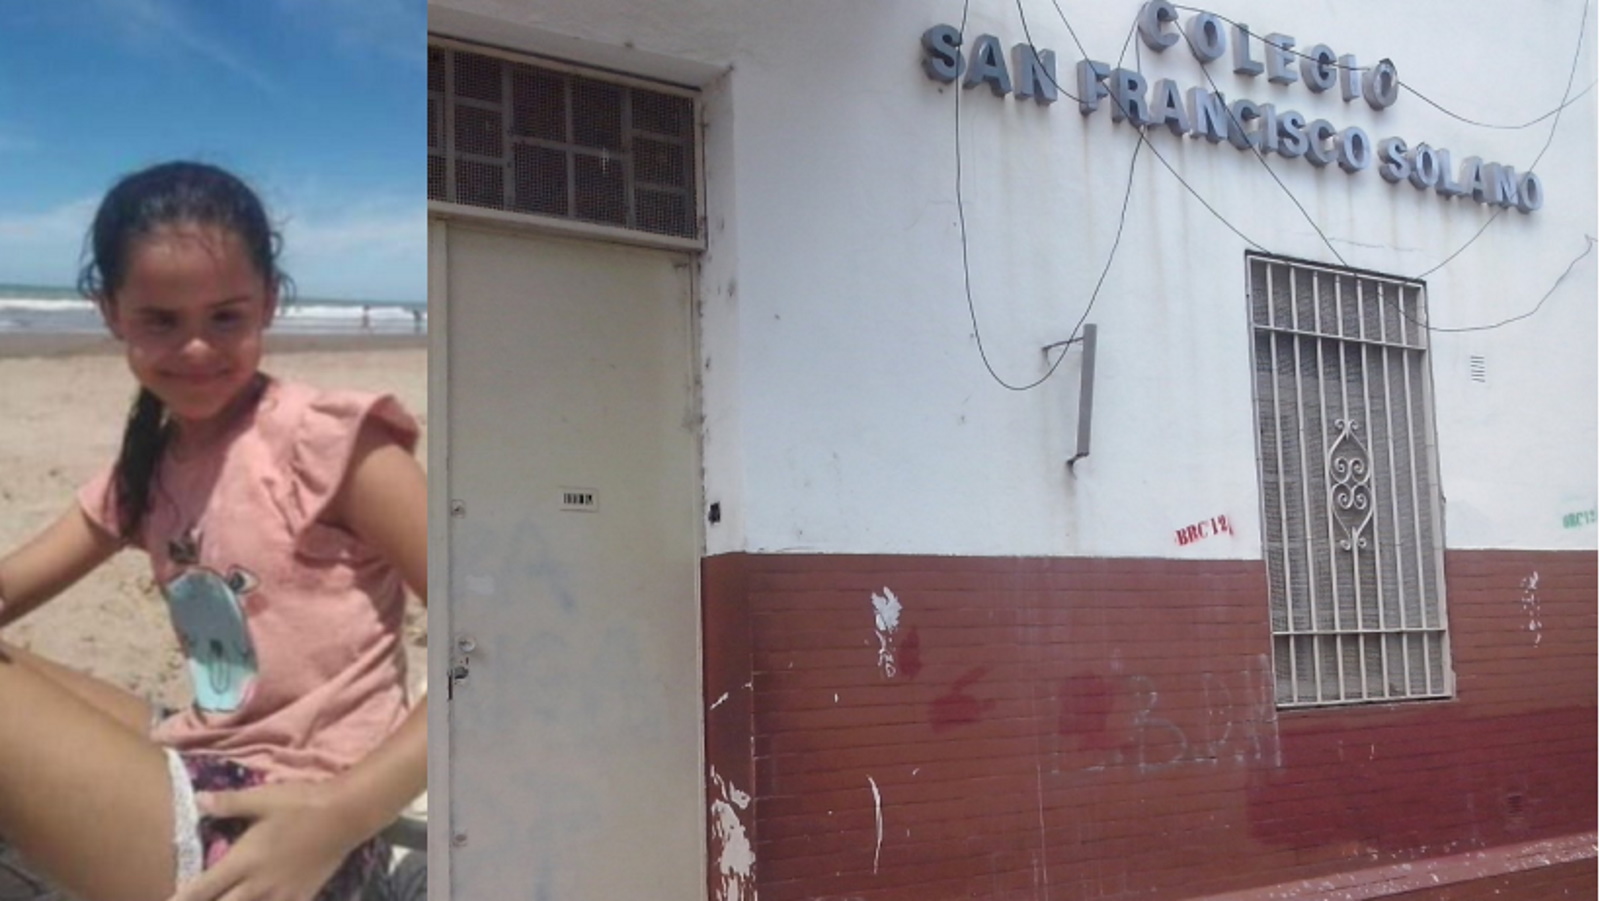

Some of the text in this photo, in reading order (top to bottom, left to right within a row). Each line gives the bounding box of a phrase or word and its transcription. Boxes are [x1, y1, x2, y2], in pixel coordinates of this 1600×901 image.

[921, 23, 1544, 214] SAN FRANCISCO SOLANO
[1137, 0, 1399, 110] COLEGIO
